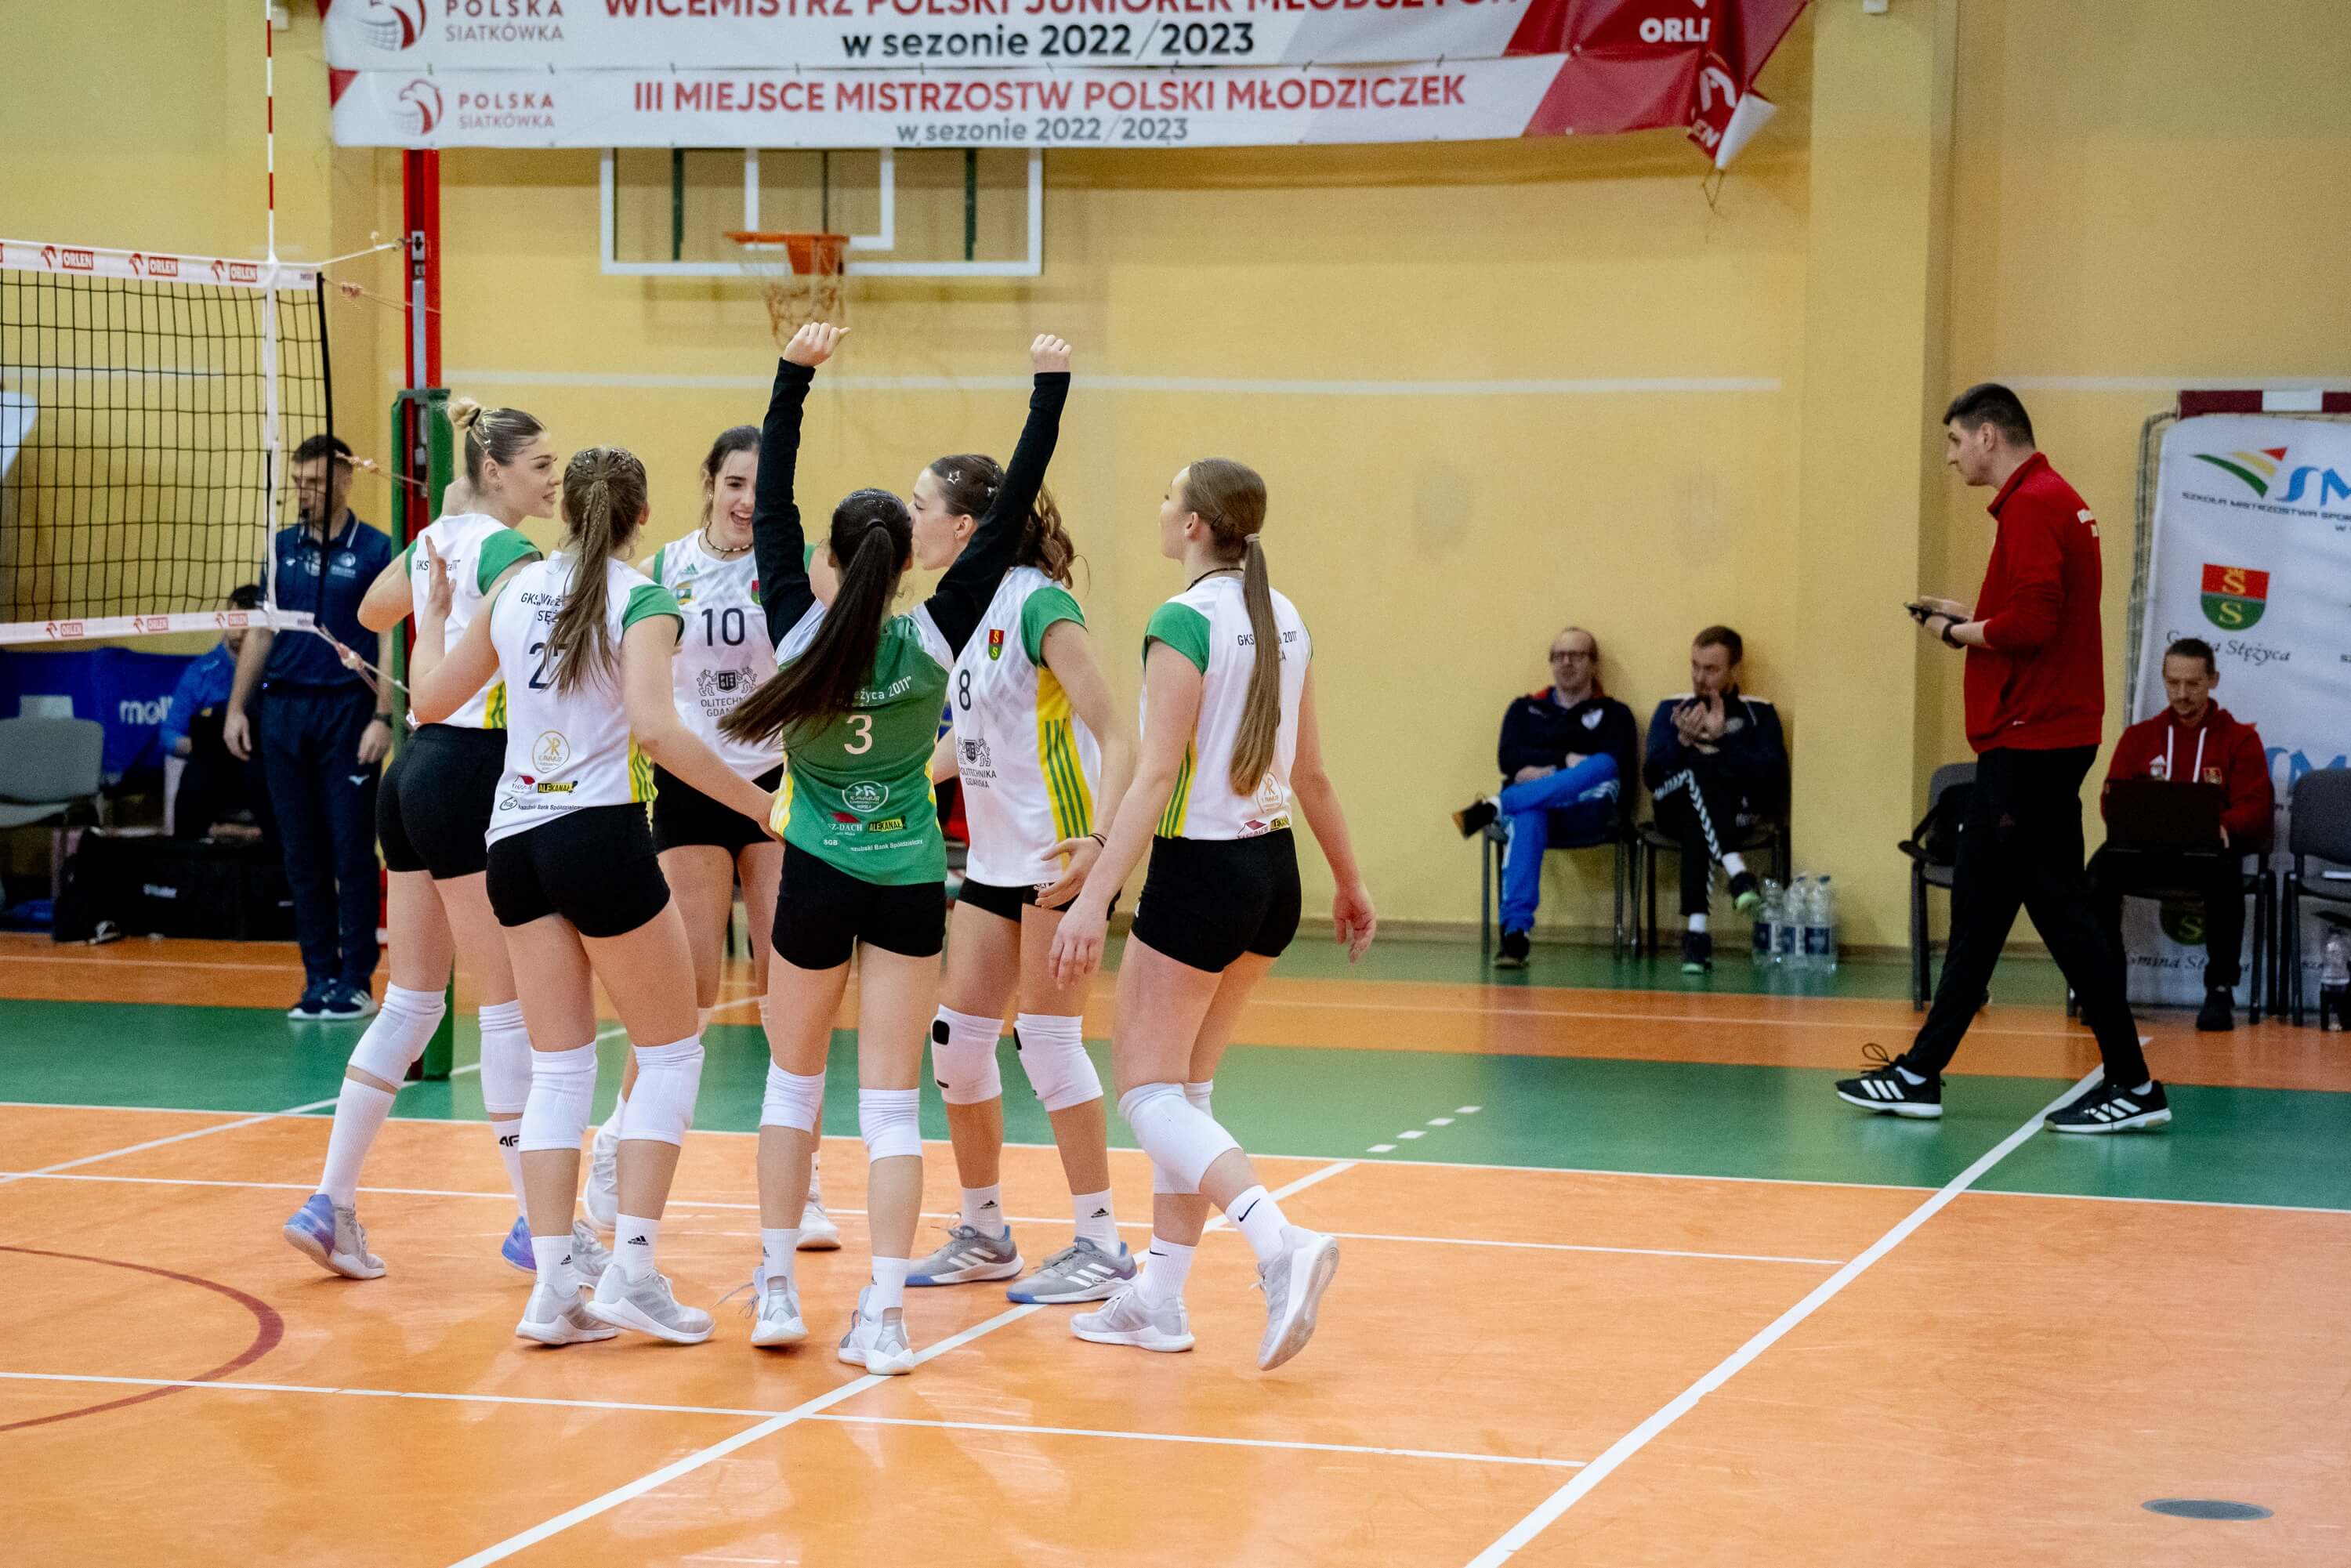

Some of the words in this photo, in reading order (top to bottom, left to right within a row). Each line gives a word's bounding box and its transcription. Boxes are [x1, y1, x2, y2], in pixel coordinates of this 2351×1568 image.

[446, 0, 563, 17] POLSKA
[445, 21, 563, 42] SIATKÓWKA
[842, 34, 871, 57] w
[883, 24, 1028, 56] sezonie
[458, 93, 554, 110] POLSKA
[634, 82, 663, 111] III
[675, 81, 824, 111] MIEJSCE
[835, 81, 1072, 111] MISTRZOSTW
[1084, 80, 1214, 110] POLSKI
[1227, 75, 1467, 110] MŁODZICZEK
[458, 113, 556, 129] SIATKÓWKA
[898, 126, 919, 141] w
[926, 118, 1027, 141] sezonie
[63, 252, 92, 269] ORLEN
[701, 607, 745, 646] 10
[1237, 633, 1255, 646] GKS
[958, 669, 971, 711] 8
[844, 714, 873, 755] 3
